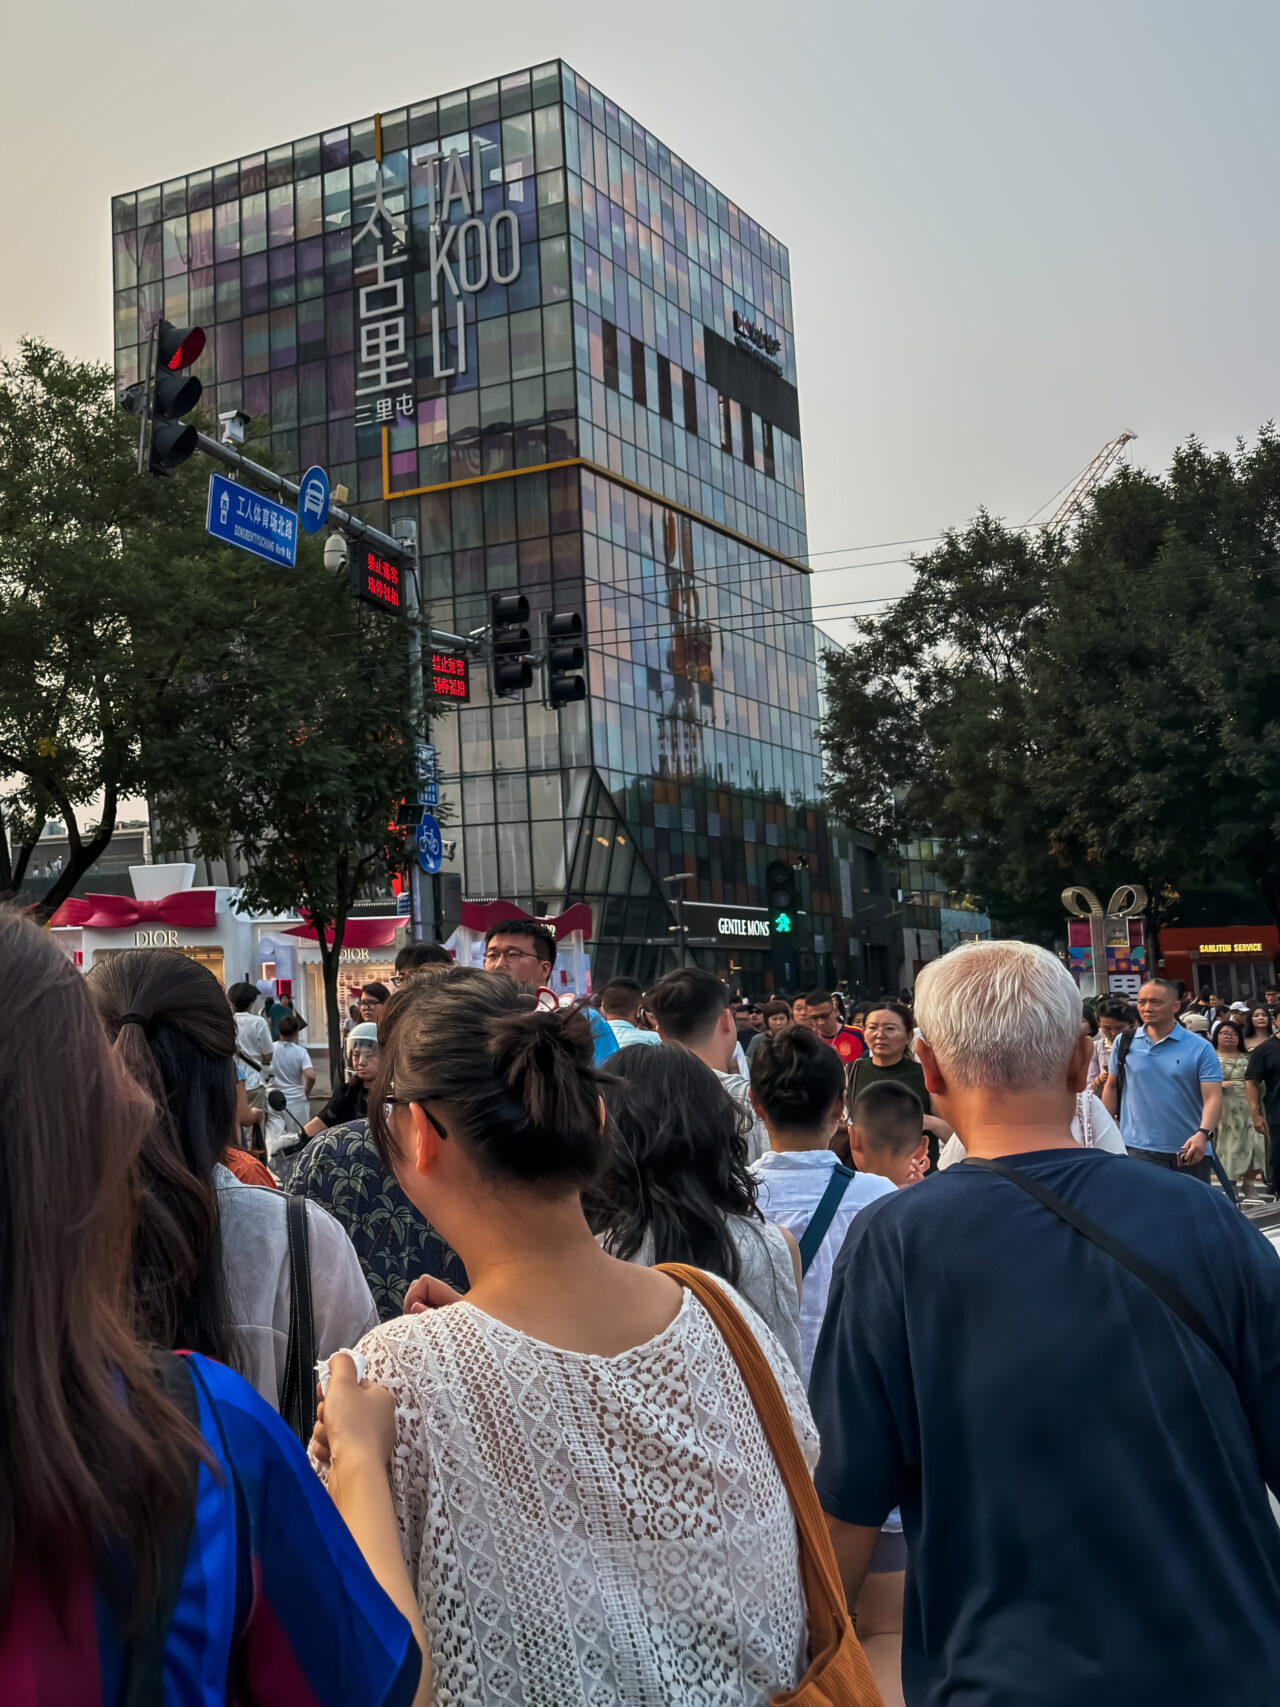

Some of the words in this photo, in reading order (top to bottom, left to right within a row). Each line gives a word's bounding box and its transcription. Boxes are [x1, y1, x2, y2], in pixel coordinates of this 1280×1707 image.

[417, 140, 483, 225] TAI
[429, 210, 520, 301] KOO
[352, 169, 413, 396] 太古里
[431, 301, 466, 378] LI
[354, 393, 414, 427] 三里屯
[236, 496, 293, 540] 工人体育场北路
[134, 930, 179, 947] DIOR
[718, 917, 747, 935] GENTLE
[747, 919, 770, 937] MONS
[1199, 944, 1232, 953] SANLITUN
[1233, 943, 1263, 952] SERVICE
